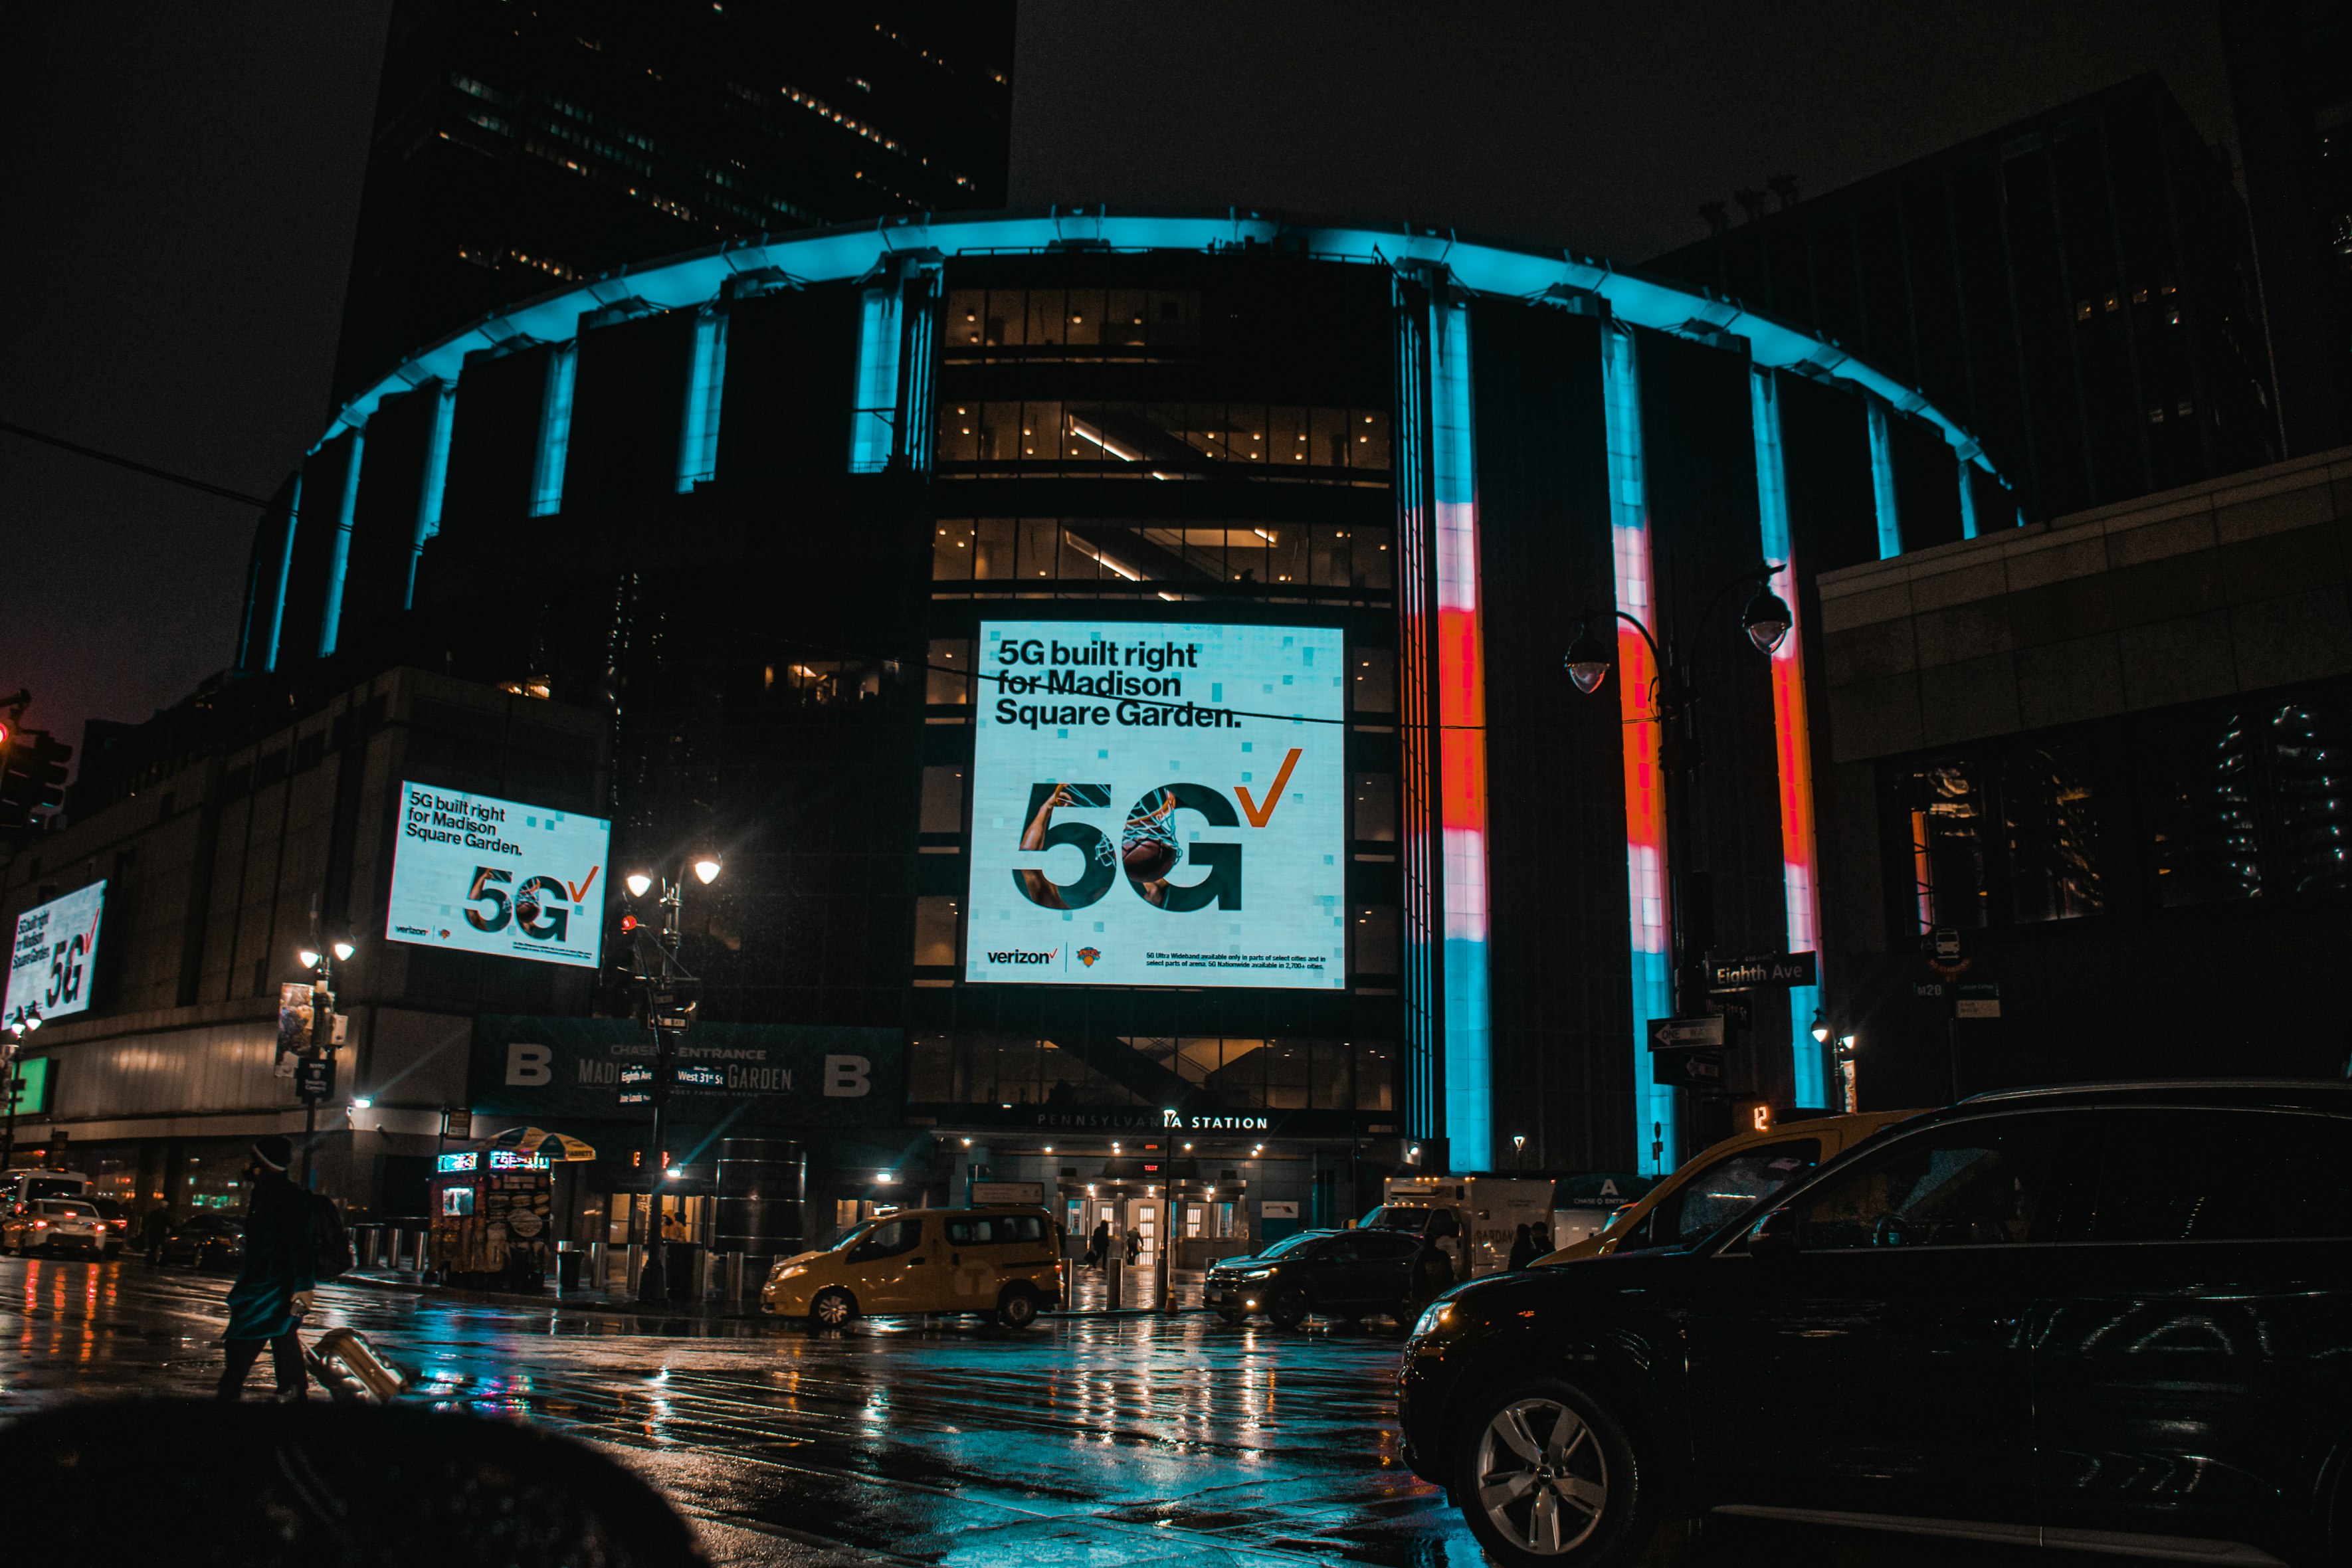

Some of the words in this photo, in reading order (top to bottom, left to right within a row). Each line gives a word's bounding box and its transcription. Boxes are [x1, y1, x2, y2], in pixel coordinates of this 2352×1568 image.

[998, 639, 1044, 666] 5G
[1052, 640, 1119, 666] built
[1125, 641, 1197, 672] right
[997, 670, 1040, 695] for
[1048, 670, 1181, 697] Madison
[995, 698, 1110, 730] Square
[1116, 700, 1242, 729] Garden.
[410, 791, 433, 808] 5G
[436, 795, 469, 815] built
[471, 803, 506, 822] right
[407, 807, 431, 823] for
[433, 811, 497, 836] Madison
[406, 823, 462, 842] Square
[465, 833, 522, 856] Garden.
[1012, 782, 1242, 913] 5G
[462, 866, 570, 942] 5G
[395, 926, 426, 935] verizon
[987, 949, 1049, 964] verizon
[45, 933, 85, 1009] 5G
[1717, 965, 1767, 987] Eighth
[1772, 964, 1803, 979] Ave
[1917, 984, 1941, 996] M20
[1661, 1030, 1680, 1041] ONE
[505, 1043, 553, 1086] B
[611, 1045, 658, 1056] CHASE
[678, 1047, 767, 1060] ENTRANCE
[677, 1070, 698, 1082] West
[715, 1075, 724, 1085] St
[728, 1064, 791, 1090] GARDEN
[823, 1054, 871, 1097] B
[1038, 1114, 1182, 1127] PENNSYLVANIA
[1191, 1116, 1268, 1129] STATION
[1599, 1179, 1619, 1196] A
